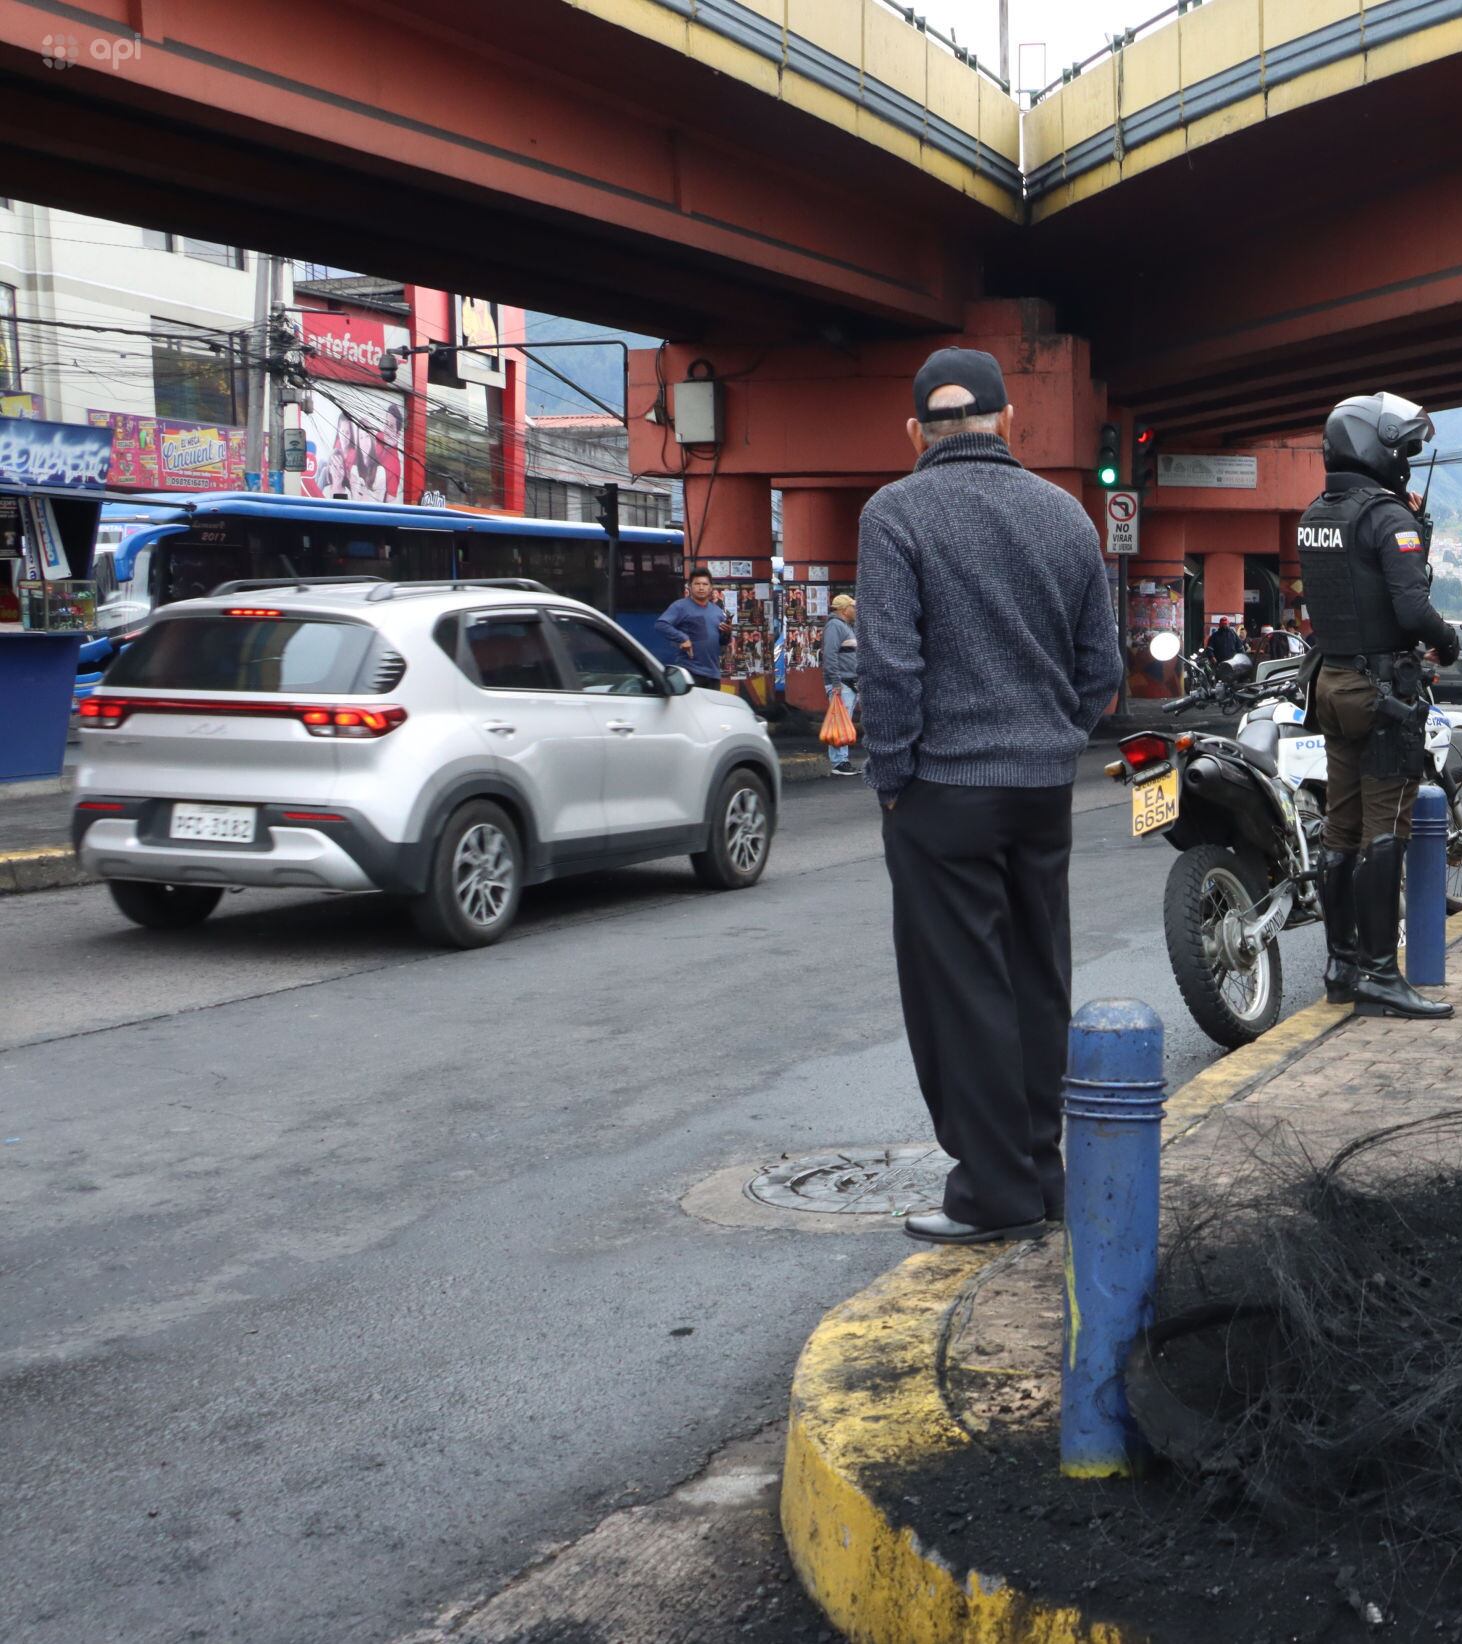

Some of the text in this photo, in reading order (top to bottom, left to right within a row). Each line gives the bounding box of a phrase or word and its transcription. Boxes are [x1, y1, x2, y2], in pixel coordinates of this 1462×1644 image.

[305, 331, 383, 367] artefacta
[1112, 534, 1132, 543] VIRAR
[1115, 523, 1130, 533] NO
[1297, 527, 1343, 548] POLICIA
[1144, 785, 1165, 808] EA
[1134, 799, 1176, 832] 665M
